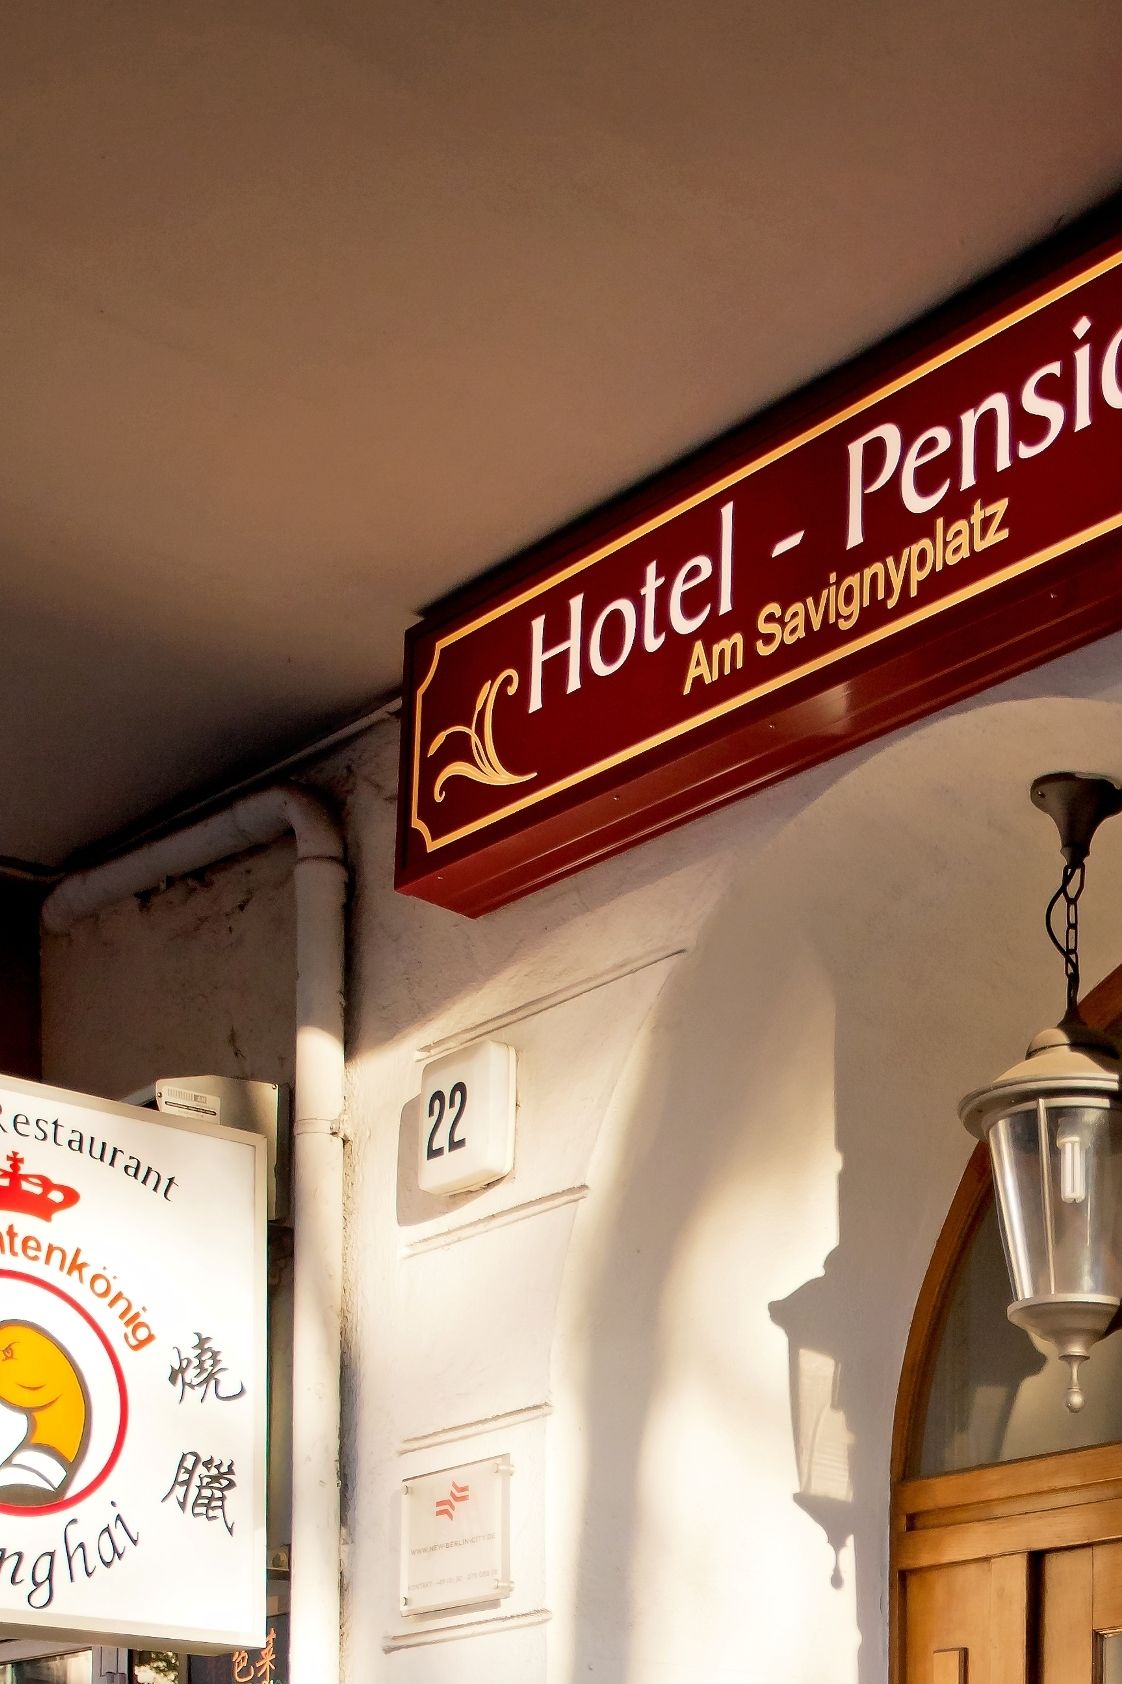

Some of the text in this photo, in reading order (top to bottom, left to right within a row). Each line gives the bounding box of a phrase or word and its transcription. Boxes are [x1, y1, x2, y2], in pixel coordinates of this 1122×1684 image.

[527, 499, 735, 714] Hotel
[771, 527, 806, 560] -
[683, 496, 1011, 695] Am Savignyplatz
[426, 1081, 468, 1161] 22
